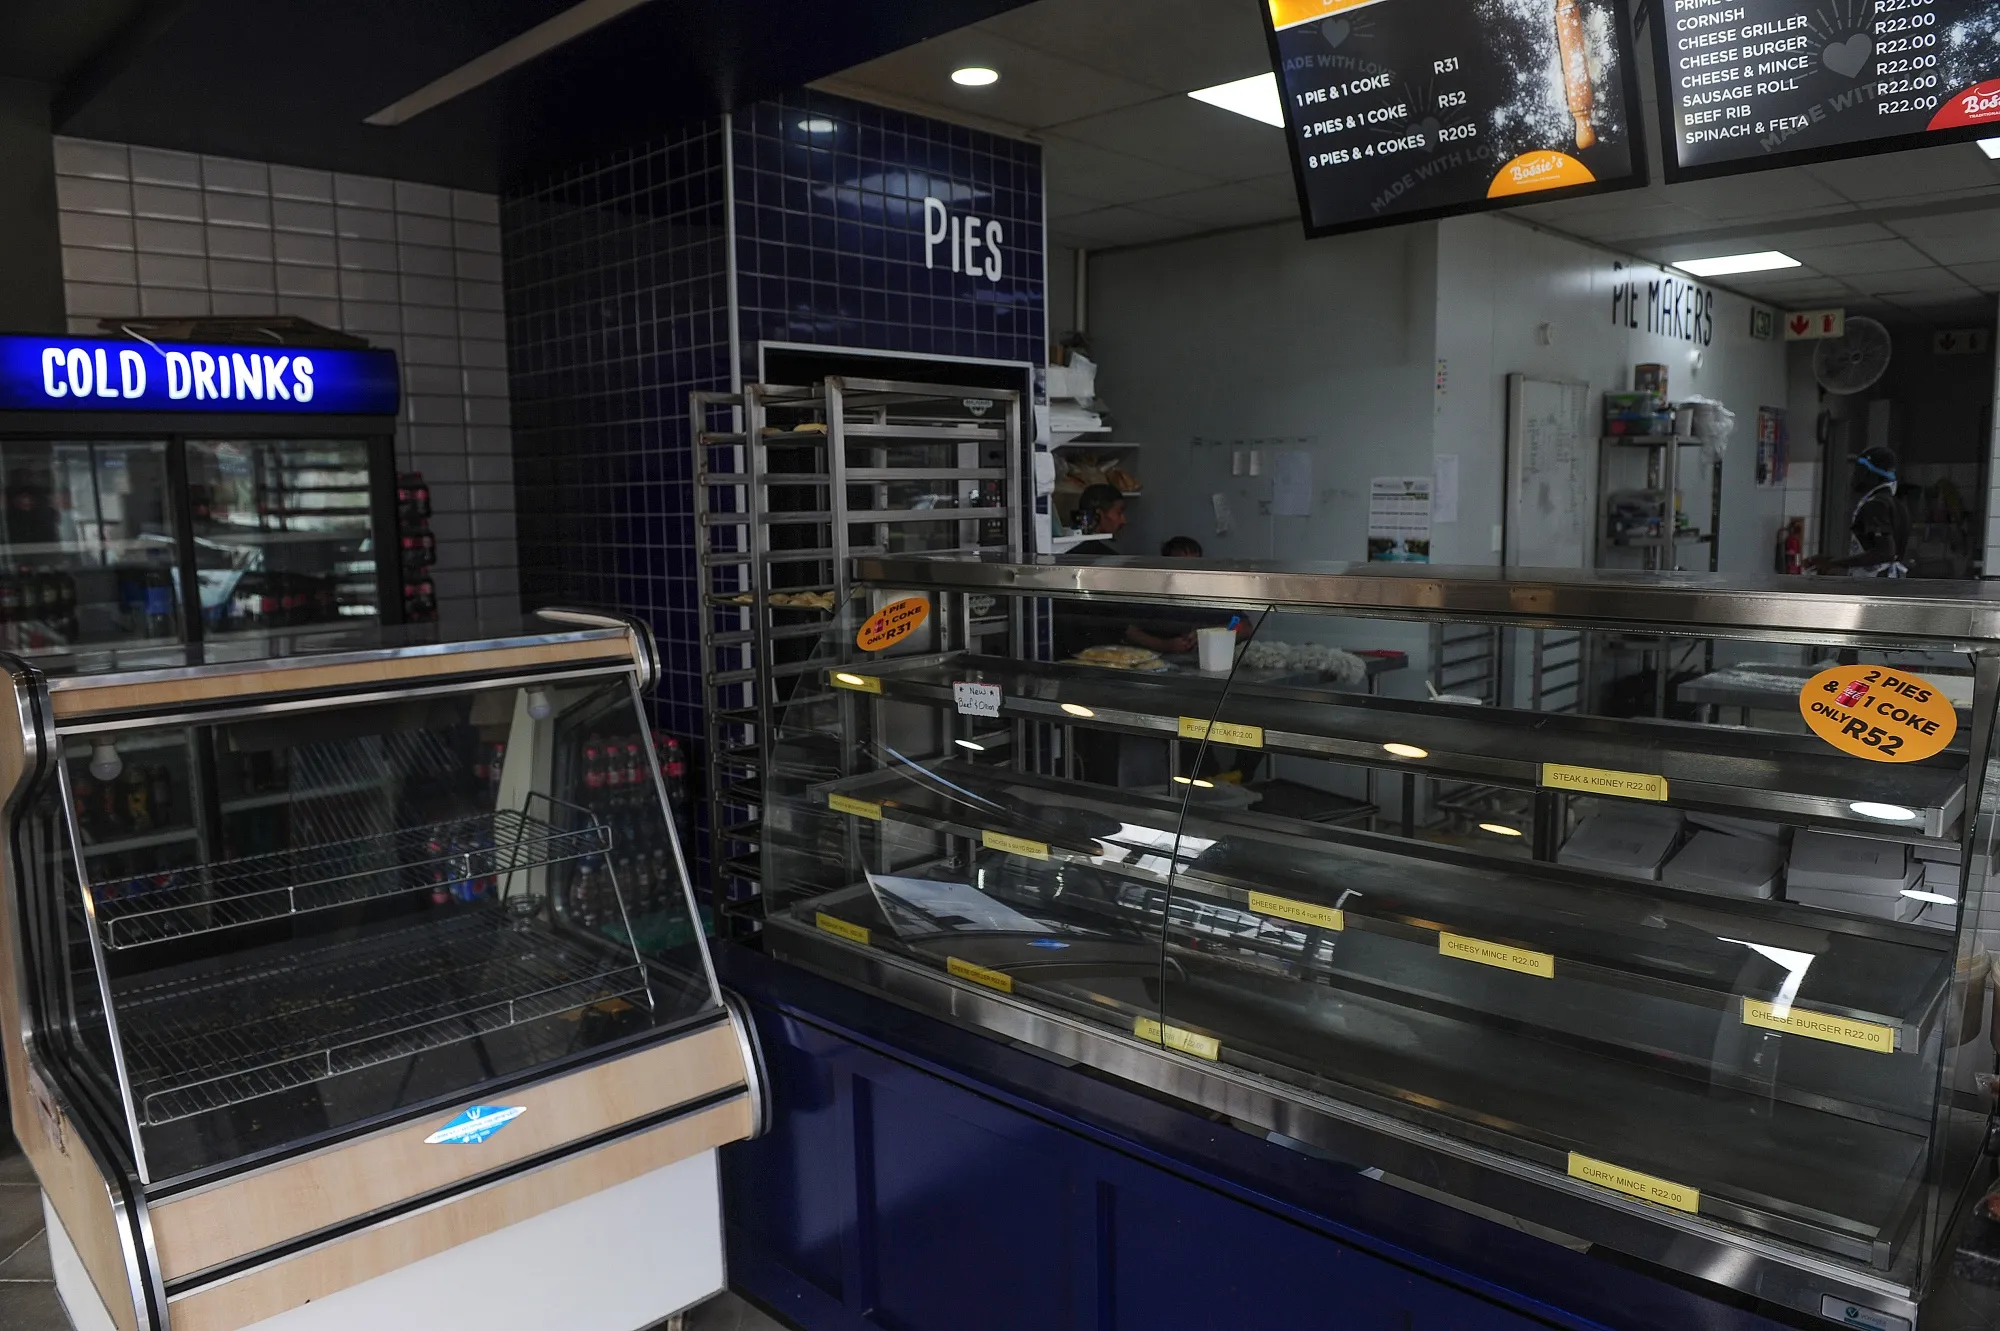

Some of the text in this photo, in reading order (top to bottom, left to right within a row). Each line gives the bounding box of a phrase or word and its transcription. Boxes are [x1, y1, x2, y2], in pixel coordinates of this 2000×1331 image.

[1676, 7, 1745, 31] CORNISH
[1678, 29, 1737, 51] CHEESE
[1741, 15, 1808, 39] GRILLER
[1679, 12, 1936, 70] CHEESE BURGER R22.00
[1317, 55, 1355, 70] WITH
[1681, 33, 1936, 88] CHEESE & MINCE R22.00
[1296, 57, 1459, 107] 1 PIE & 1 COKE R31
[1682, 54, 1937, 107] SAUSAGE ROLL R22.00
[1303, 90, 1467, 139] 2 PIES & 1 COKE R52
[1684, 109, 1722, 126] BEEF
[1726, 105, 1751, 119] RIB
[1877, 75, 1938, 96] R22.00
[1961, 95, 2000, 114] Bos
[1685, 95, 1938, 144] SPINACH & FETA R22.00
[1308, 123, 1477, 169] 8 PIES & 4 COKES R205
[1370, 173, 1416, 213] MADE
[1415, 154, 1463, 181] WITH
[924, 196, 1003, 282] PIES
[1612, 261, 1713, 346] PIE MAKERS
[41, 347, 314, 403] COLD DRINKS
[889, 602, 906, 614] PIE
[892, 605, 922, 622] COKE
[867, 621, 911, 645] ONLY R31
[970, 687, 987, 696] New
[1864, 671, 1881, 683] 2
[1881, 677, 1933, 703] PIES
[1823, 680, 1839, 694] &
[1864, 696, 1876, 708] 1
[1877, 703, 1940, 736] COKE
[1186, 724, 1253, 740] PEPPE STEAK R22.00
[1811, 702, 1904, 756] ONLY R52
[1553, 773, 1581, 782] STEAK
[1591, 778, 1624, 788] KIDNEY
[1626, 782, 1656, 792] R22.00
[1251, 898, 1277, 911] CHEESE
[1278, 905, 1300, 916] PUFFS
[1318, 913, 1331, 922] R15
[1447, 941, 1540, 968] CHEESY MINCE R22.00
[1796, 1020, 1841, 1035] BURGER
[1845, 1029, 1880, 1042] R22.00
[1582, 1166, 1682, 1202] CURRY MINCE R22.00
